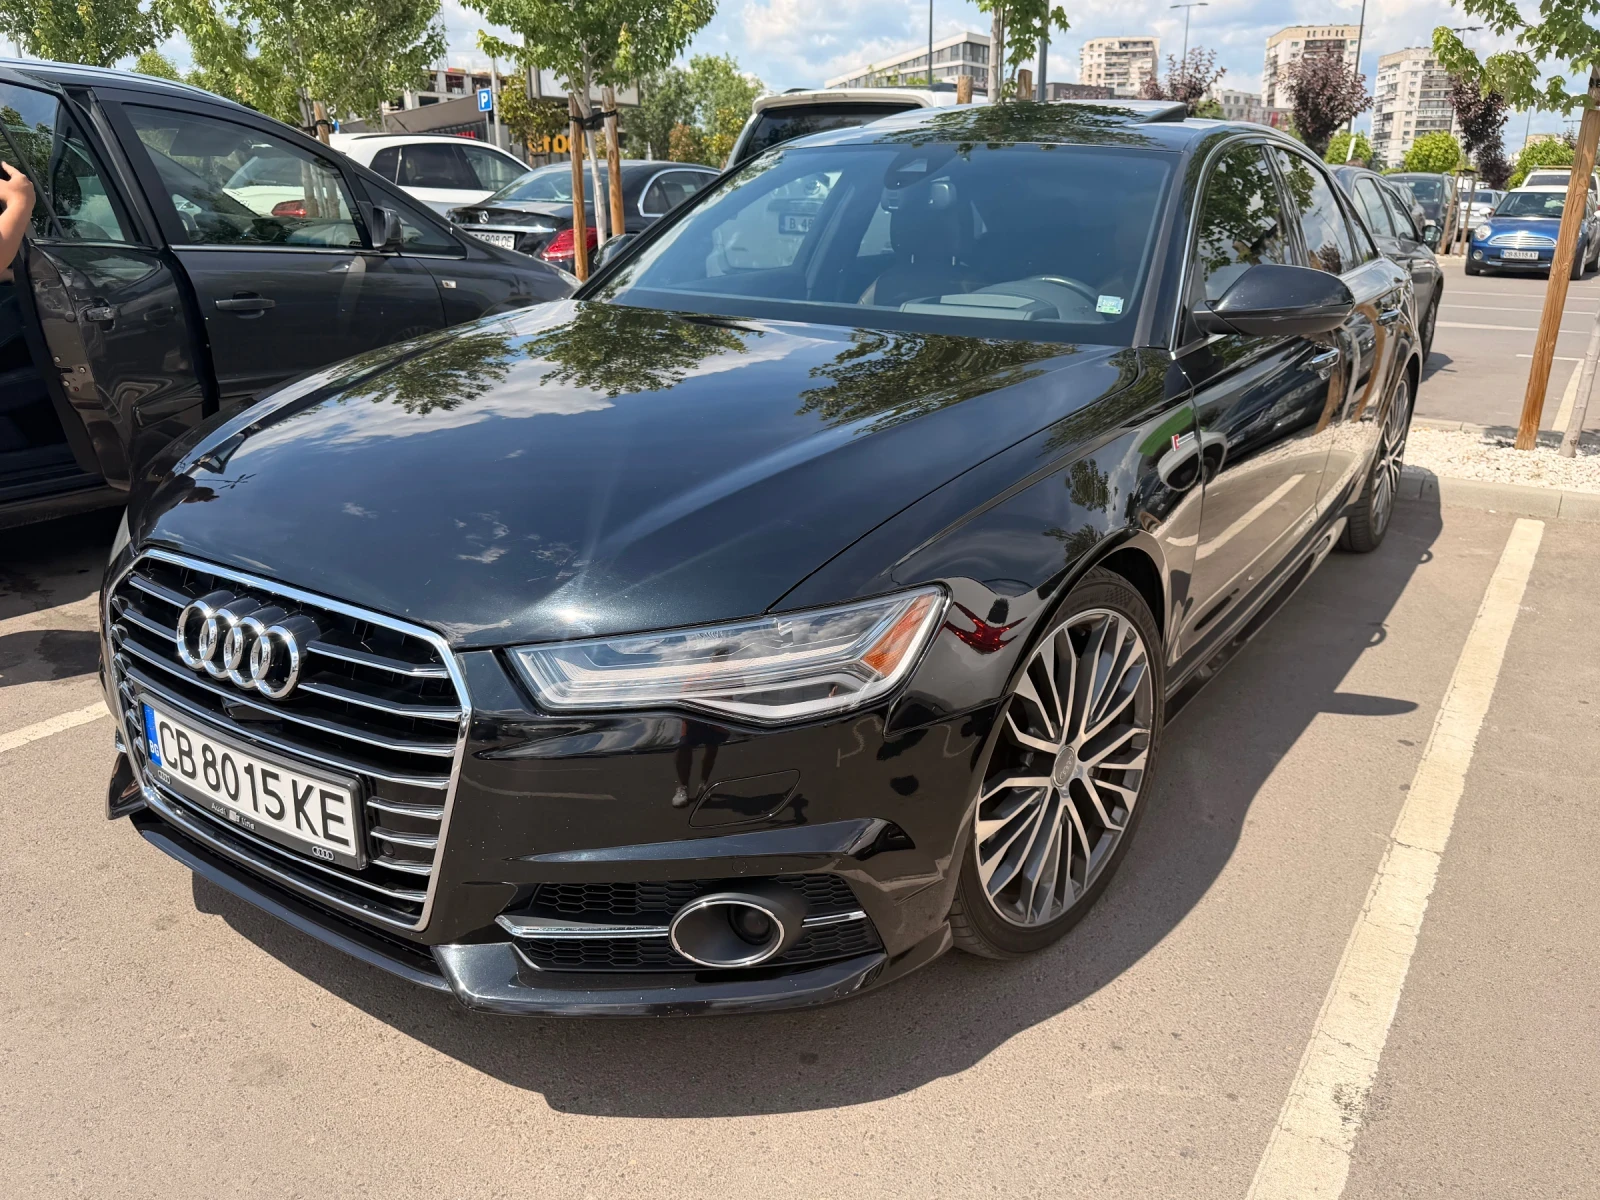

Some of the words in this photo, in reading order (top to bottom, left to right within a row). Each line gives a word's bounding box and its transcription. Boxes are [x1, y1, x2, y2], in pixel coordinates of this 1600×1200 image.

[480, 91, 489, 108] P
[149, 738, 160, 757] BG
[159, 721, 197, 780] CB
[201, 743, 286, 822] 8015
[291, 779, 350, 847] KE
[211, 802, 227, 816] Audi
